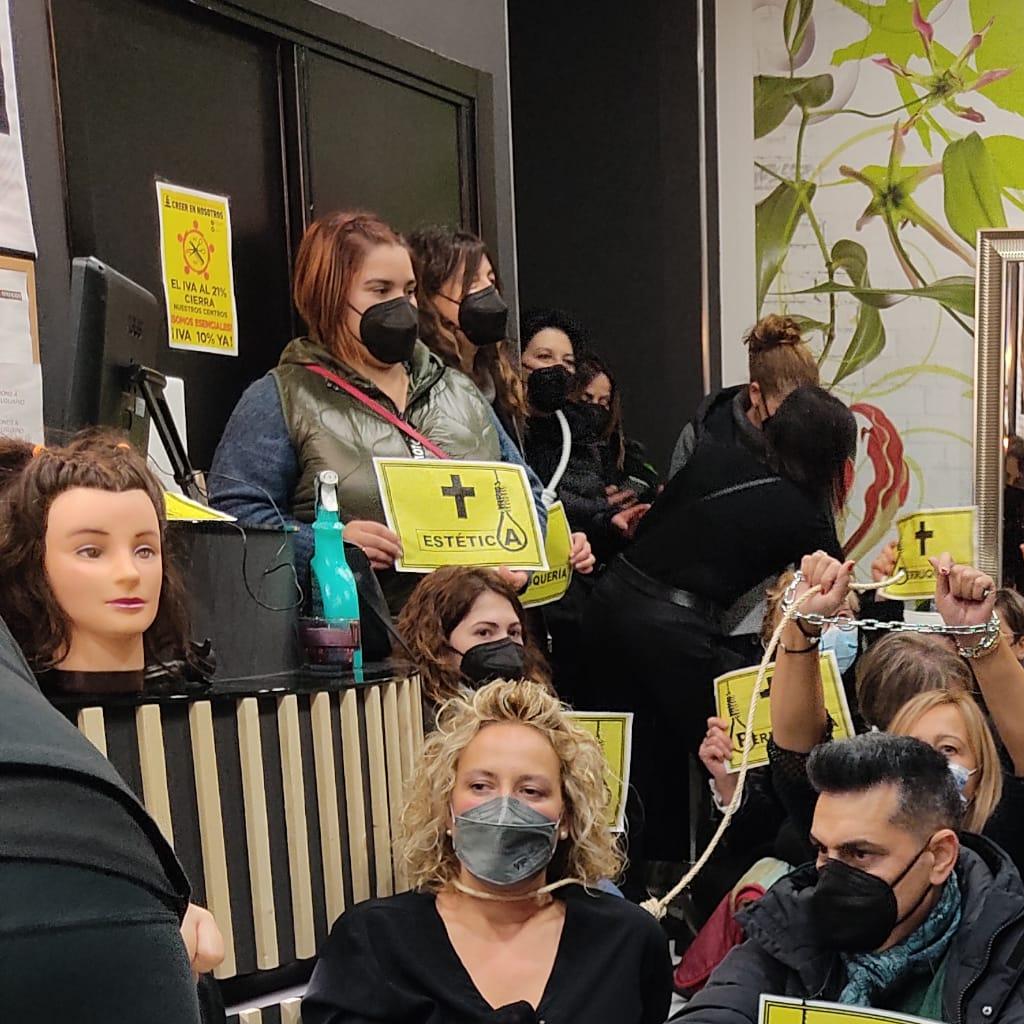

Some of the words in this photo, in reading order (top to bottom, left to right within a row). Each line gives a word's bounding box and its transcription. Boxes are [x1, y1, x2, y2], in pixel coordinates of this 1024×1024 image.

[189, 204, 196, 213] EN
[171, 279, 180, 290] EL
[183, 281, 197, 292] IVA
[200, 284, 210, 295] AL
[212, 286, 227, 298] 21%
[184, 294, 215, 308] CIERRA
[173, 304, 201, 315] NUESTROS
[203, 308, 228, 318] CENTROS
[196, 331, 215, 344] 10%
